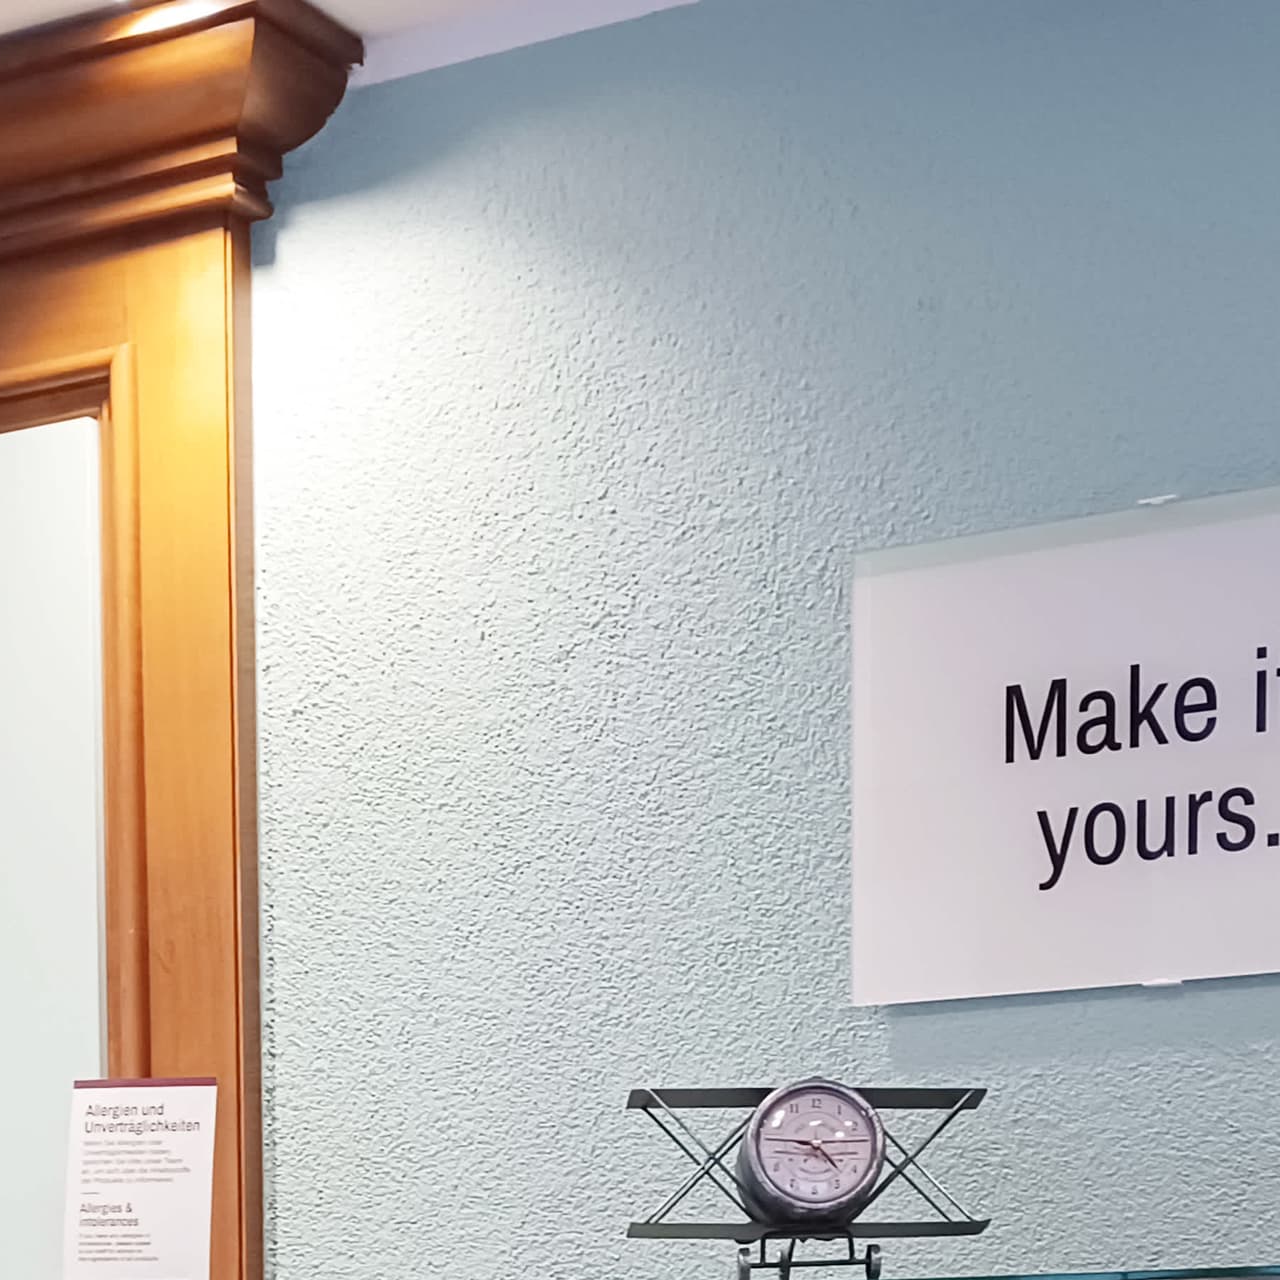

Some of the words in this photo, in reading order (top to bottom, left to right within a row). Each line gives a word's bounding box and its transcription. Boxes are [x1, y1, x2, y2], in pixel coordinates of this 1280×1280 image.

[1004, 663, 1219, 765] Make
[1036, 785, 1280, 891] yours.
[141, 1103, 165, 1116] und
